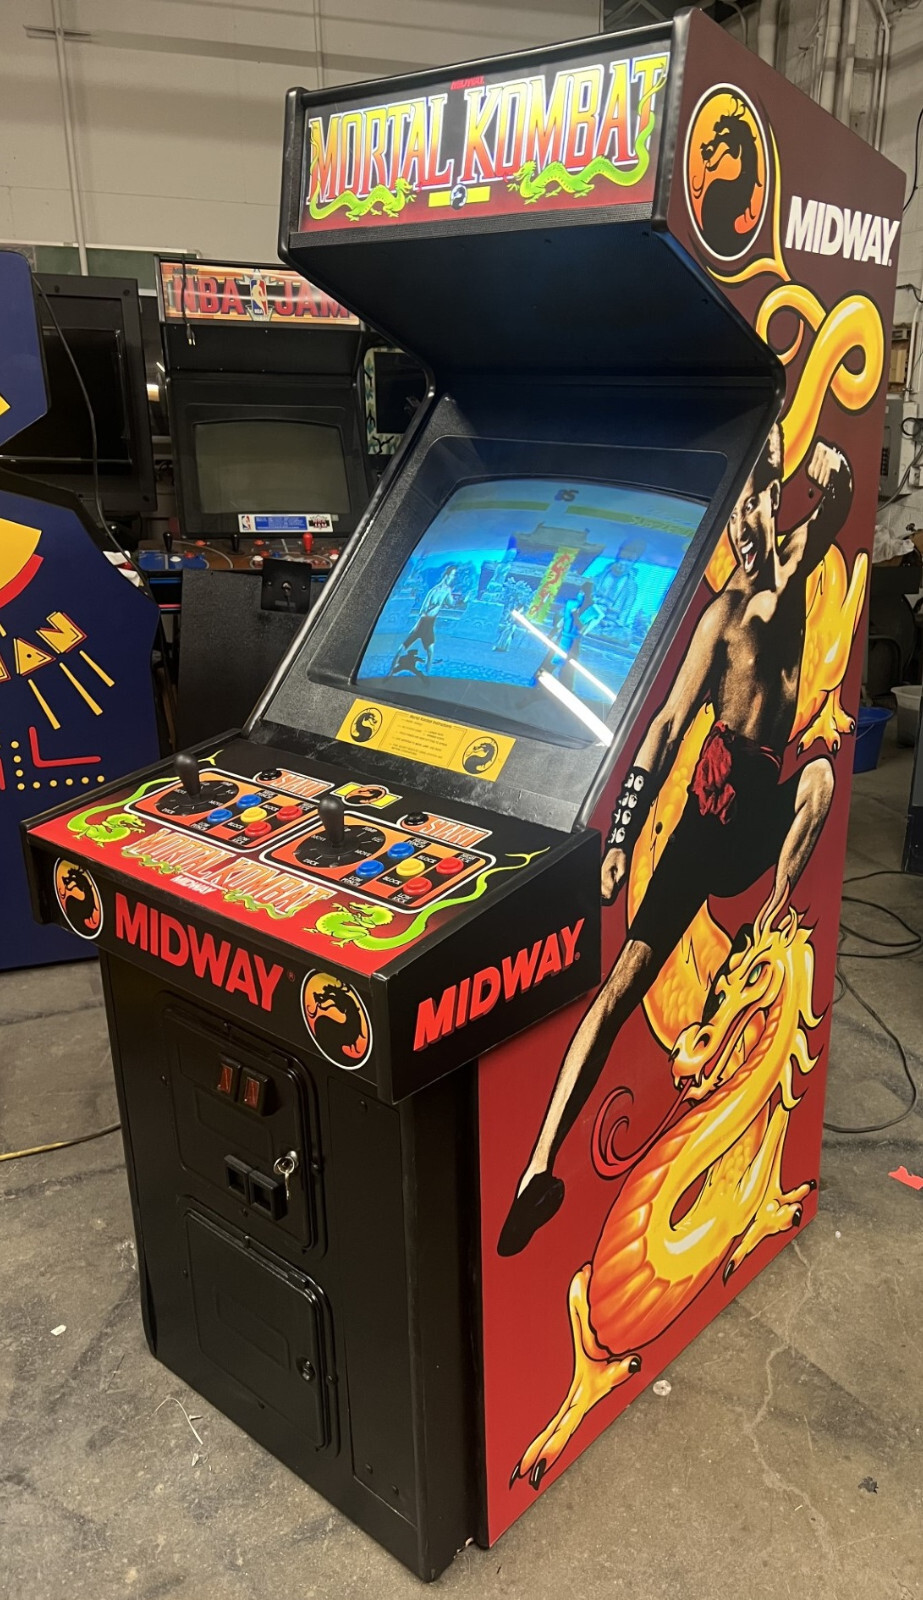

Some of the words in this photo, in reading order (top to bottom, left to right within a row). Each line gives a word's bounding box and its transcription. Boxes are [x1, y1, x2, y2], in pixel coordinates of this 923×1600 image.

[306, 93, 454, 205] MORTAL
[456, 52, 671, 184] KOMBAT
[784, 195, 901, 267] MIDWAY
[172, 274, 246, 316] NBA
[270, 773, 328, 798] START
[421, 819, 487, 847] START
[122, 827, 237, 880] MORTAL
[208, 856, 338, 914] KOMBAT
[382, 876, 401, 886] BLOCK
[417, 855, 437, 865] BLOCK
[169, 874, 219, 895] MIDWAY
[115, 892, 284, 1012] MIDWAY
[413, 917, 585, 1053] MIDWAY
